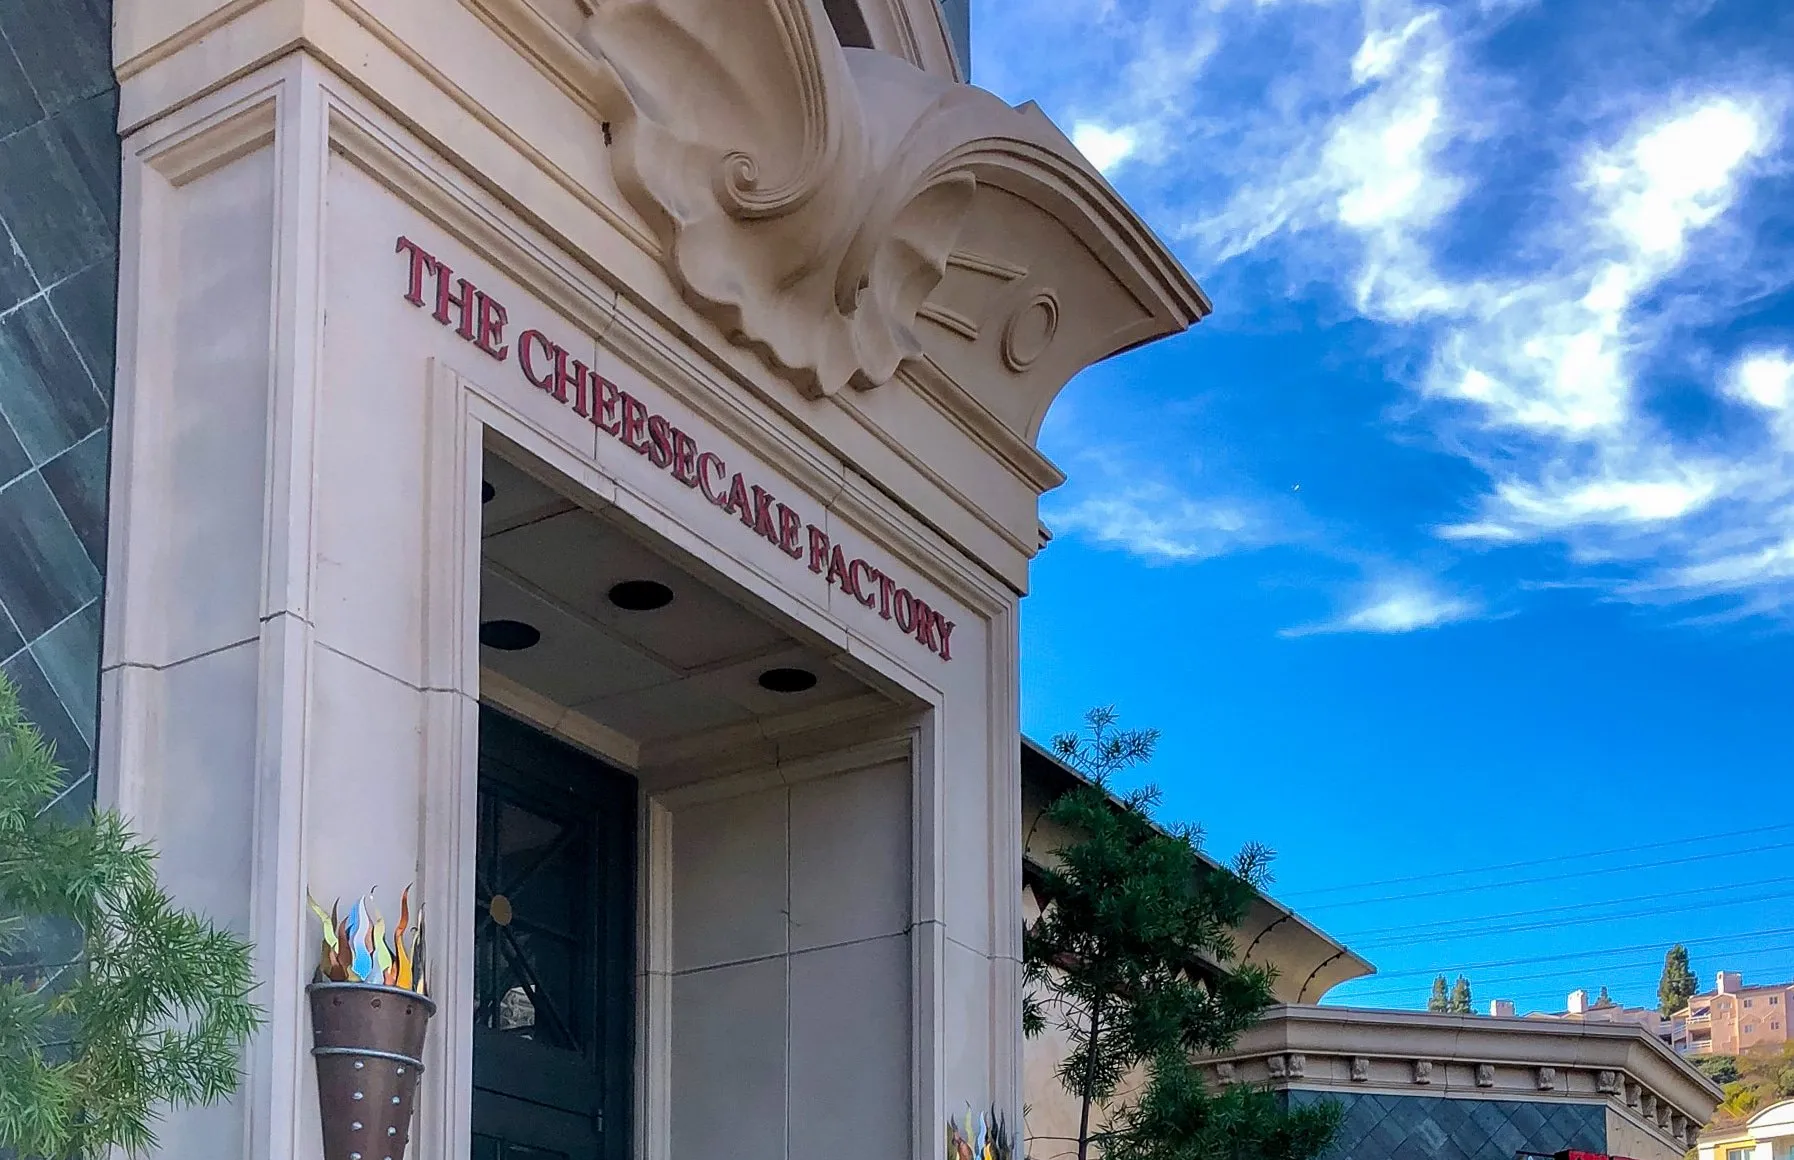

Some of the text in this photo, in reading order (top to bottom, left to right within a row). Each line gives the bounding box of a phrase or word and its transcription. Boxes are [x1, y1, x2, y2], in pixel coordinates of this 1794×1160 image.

[395, 236, 955, 661] THE CHEESECAKE FACTORY
